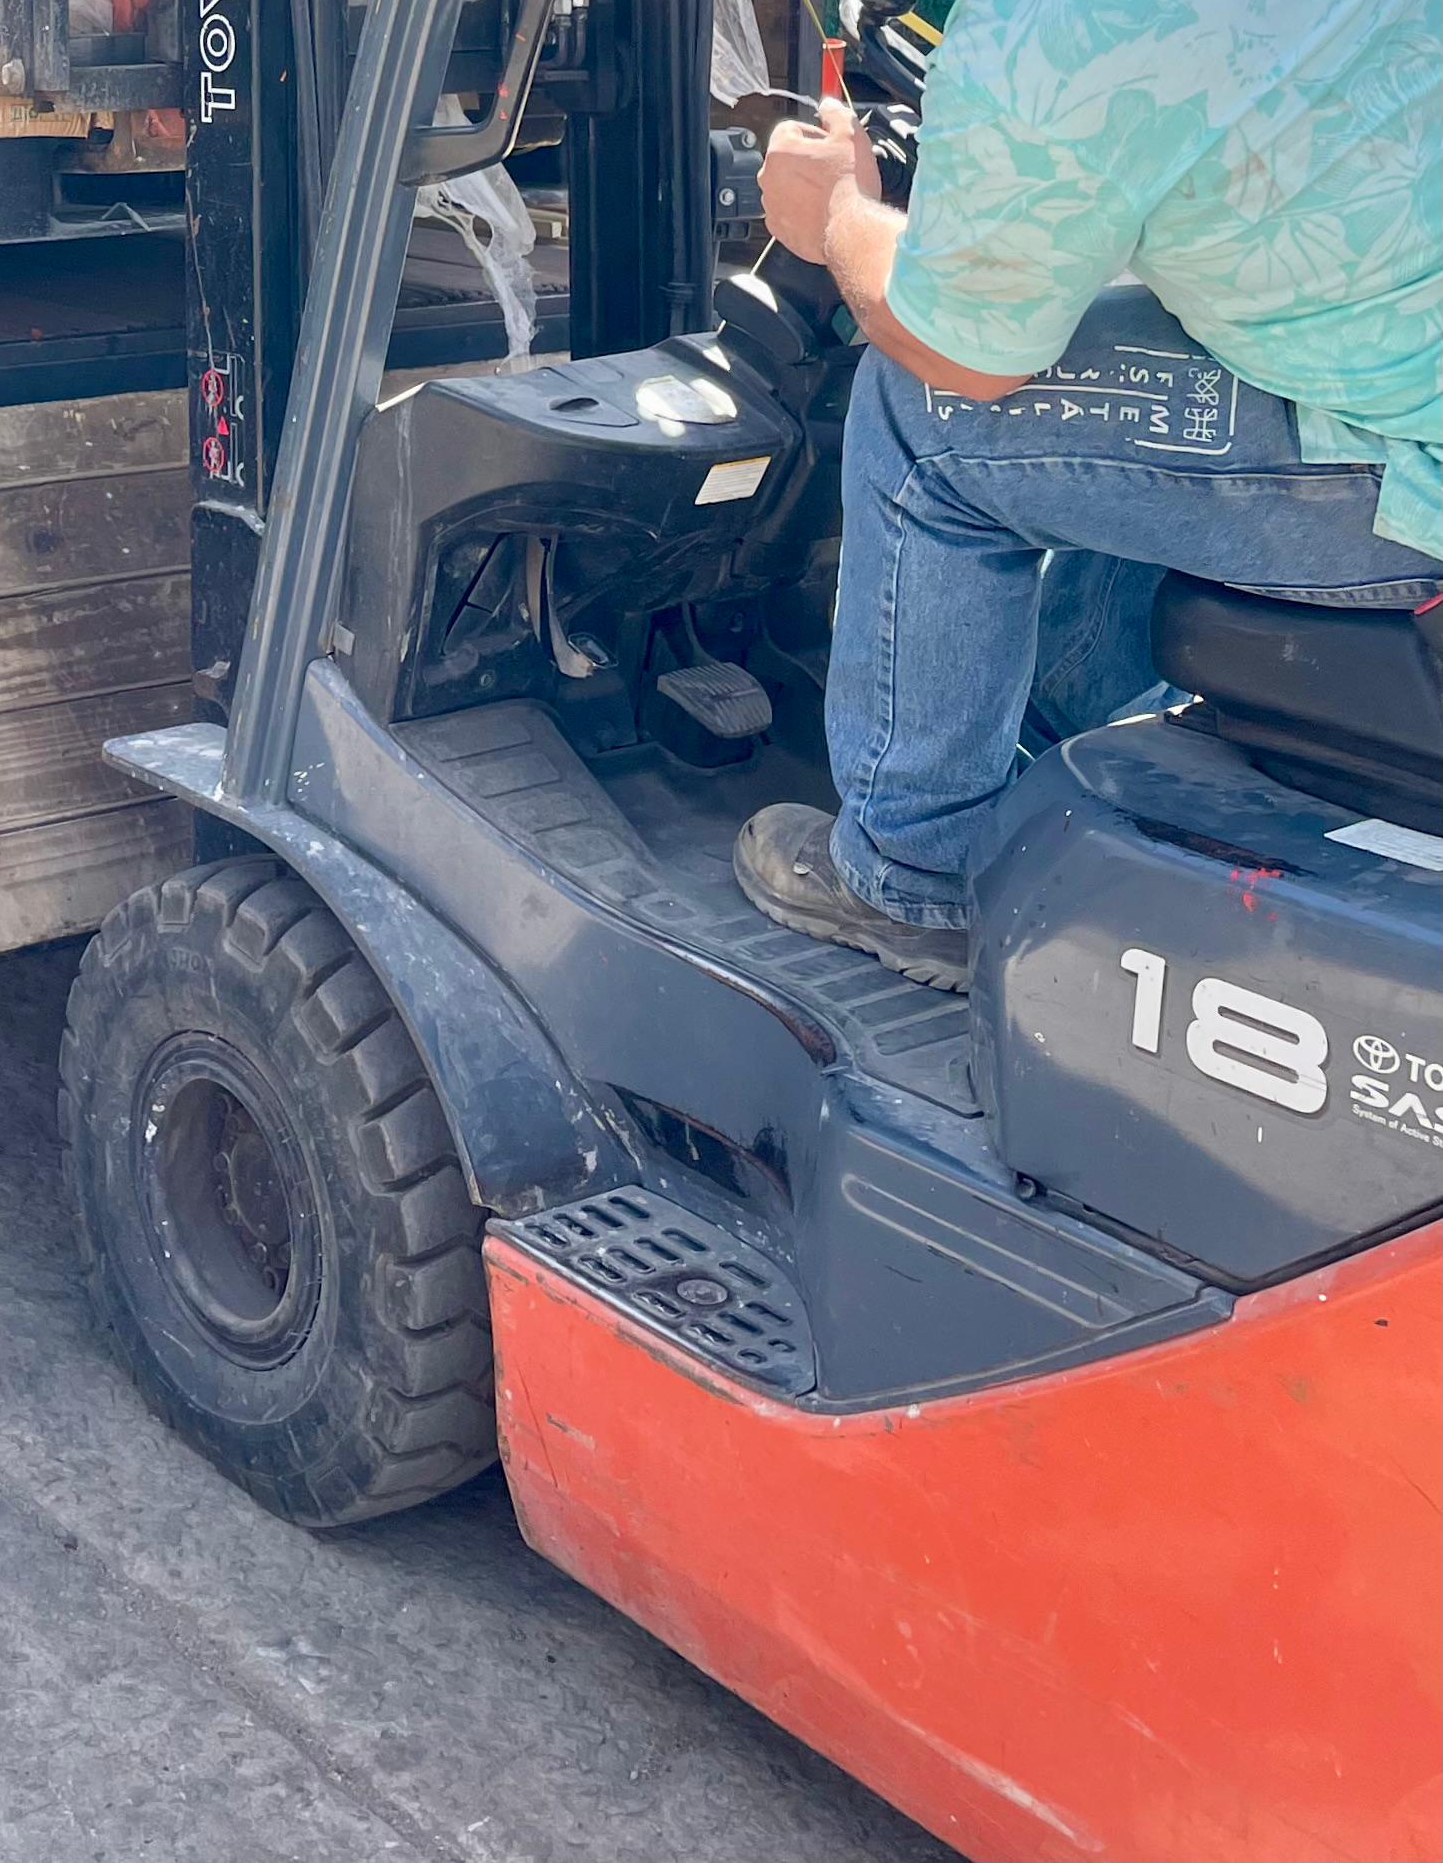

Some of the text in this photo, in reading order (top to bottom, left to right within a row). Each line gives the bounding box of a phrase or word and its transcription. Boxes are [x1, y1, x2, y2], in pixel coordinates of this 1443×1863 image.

[1120, 947, 1329, 1115] 18
[1350, 1074, 1443, 1134] SA
[1351, 1103, 1387, 1126] System
[1388, 1120, 1398, 1130] of
[1400, 1123, 1430, 1143] Active
